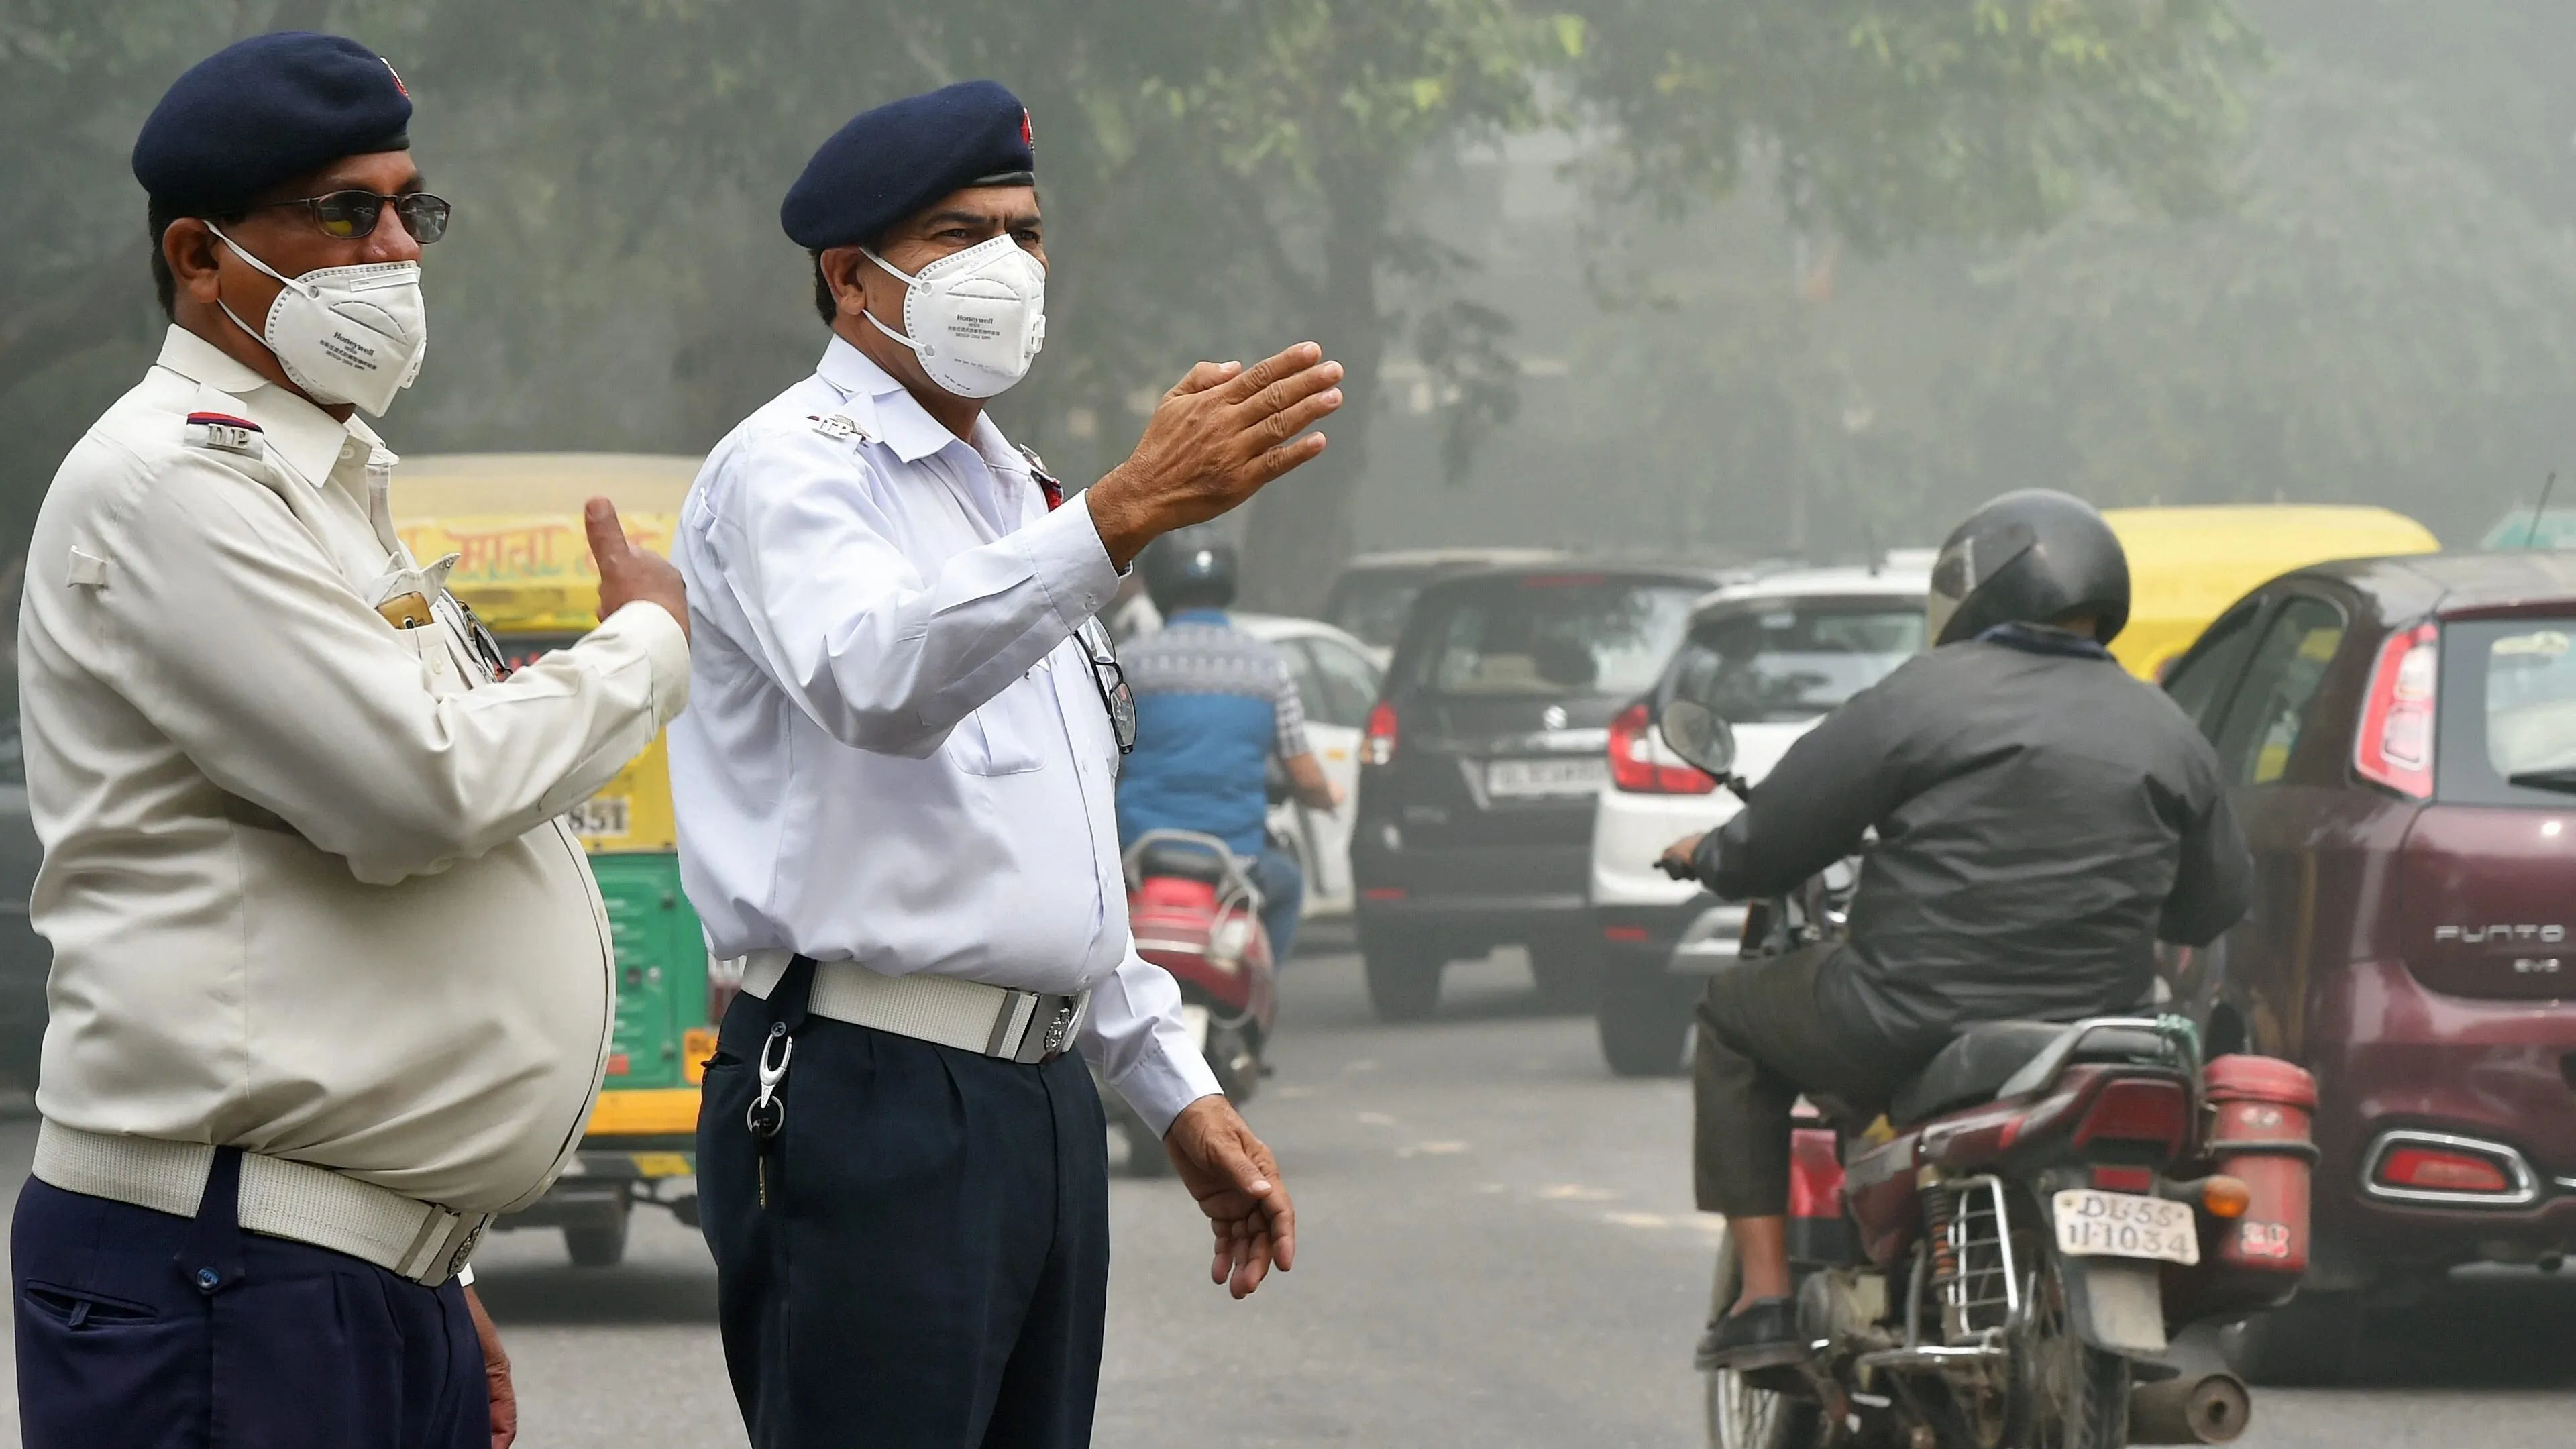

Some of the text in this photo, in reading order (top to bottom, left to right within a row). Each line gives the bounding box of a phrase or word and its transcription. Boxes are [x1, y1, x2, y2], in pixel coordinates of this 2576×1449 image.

[957, 314, 994, 325] Honeywell
[333, 331, 374, 356] Honeywell
[2434, 924, 2565, 943] PUNTO
